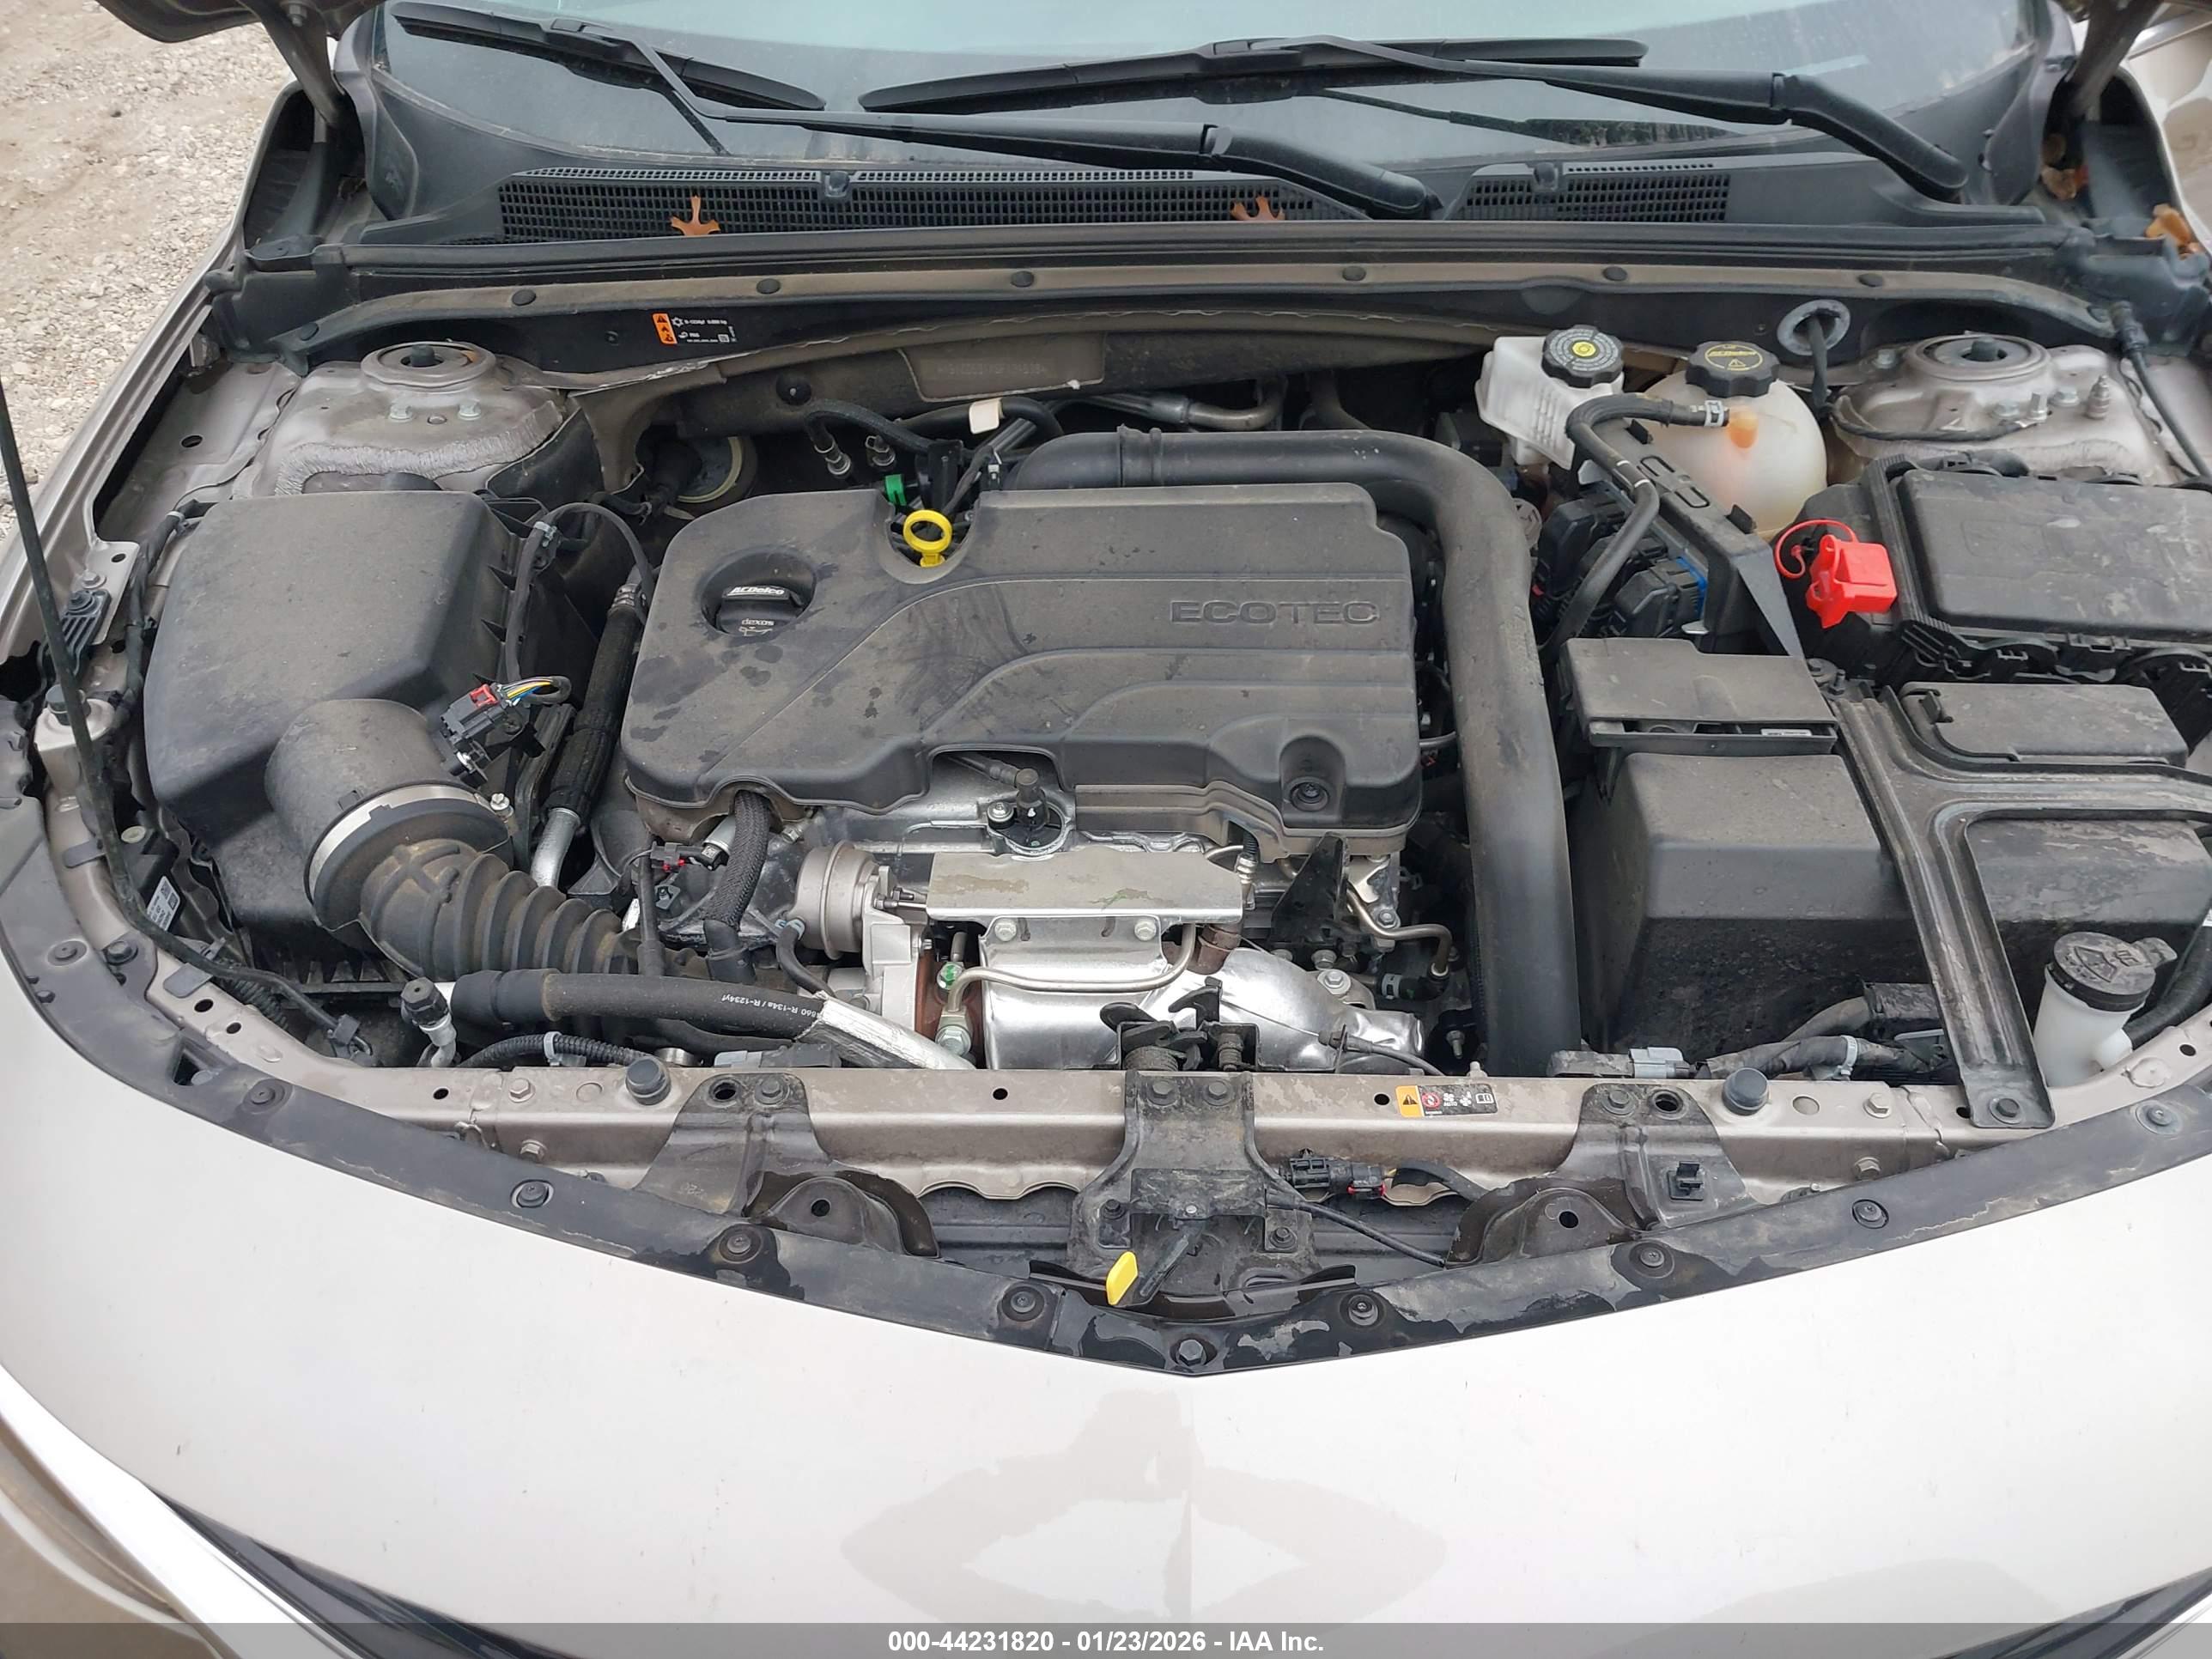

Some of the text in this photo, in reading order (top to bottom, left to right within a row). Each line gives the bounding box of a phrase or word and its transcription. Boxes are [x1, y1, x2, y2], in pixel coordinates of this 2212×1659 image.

[728, 586, 785, 595] ACDelco
[1170, 600, 1380, 625] ECOTEC
[721, 994, 762, 1007] R-1234yf
[768, 1001, 799, 1014] R-134a
